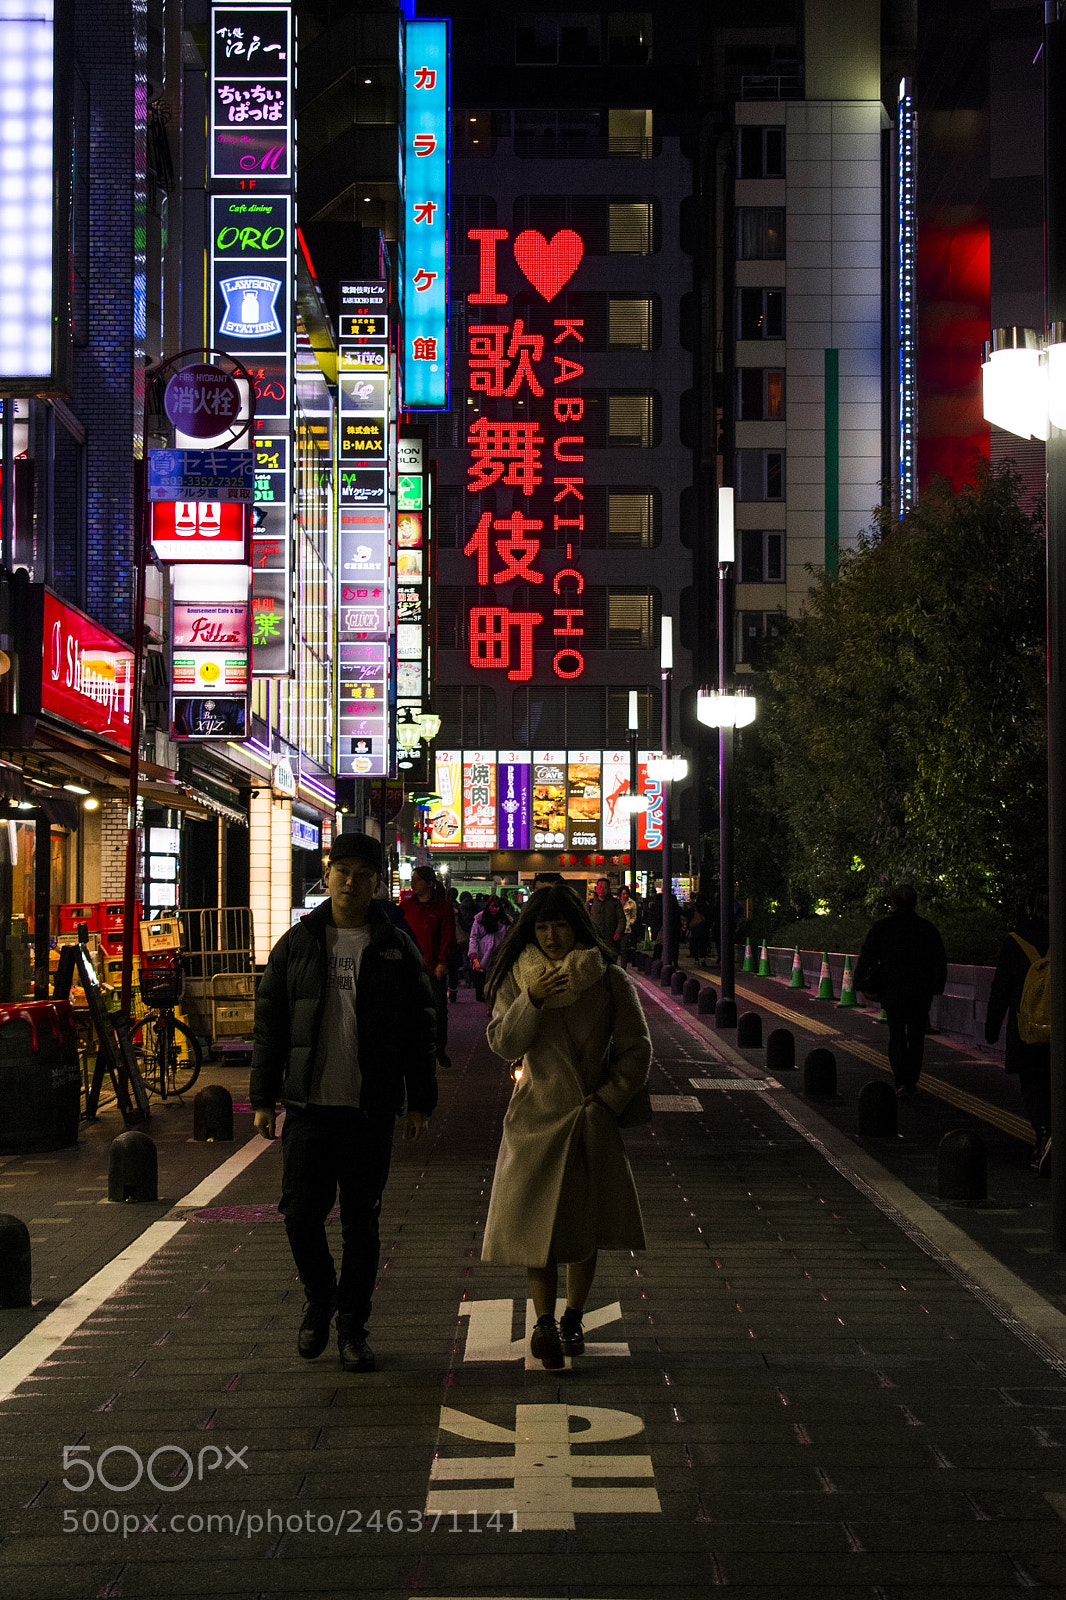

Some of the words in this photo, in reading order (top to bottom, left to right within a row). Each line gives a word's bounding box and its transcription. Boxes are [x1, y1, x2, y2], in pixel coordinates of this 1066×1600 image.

[217, 85, 282, 105] ちいちい
[228, 101, 284, 121] ぱっぱ
[228, 204, 247, 214] Cafe
[248, 204, 273, 214] dining
[411, 65, 439, 362] カラオケ館
[217, 226, 285, 251] ORO
[225, 281, 276, 292] LAWSON
[225, 321, 276, 334] STATION
[179, 373, 194, 381] FIRE
[196, 374, 228, 383] HYDRANT
[171, 386, 235, 416] 消火栓
[174, 488, 219, 499] アルタ裏
[227, 488, 251, 499] 買取
[463, 318, 545, 682] 歌舞伎町
[553, 319, 585, 679] KABUKI-CHO
[470, 763, 491, 806] 焼肉
[571, 837, 597, 846] SUNS
